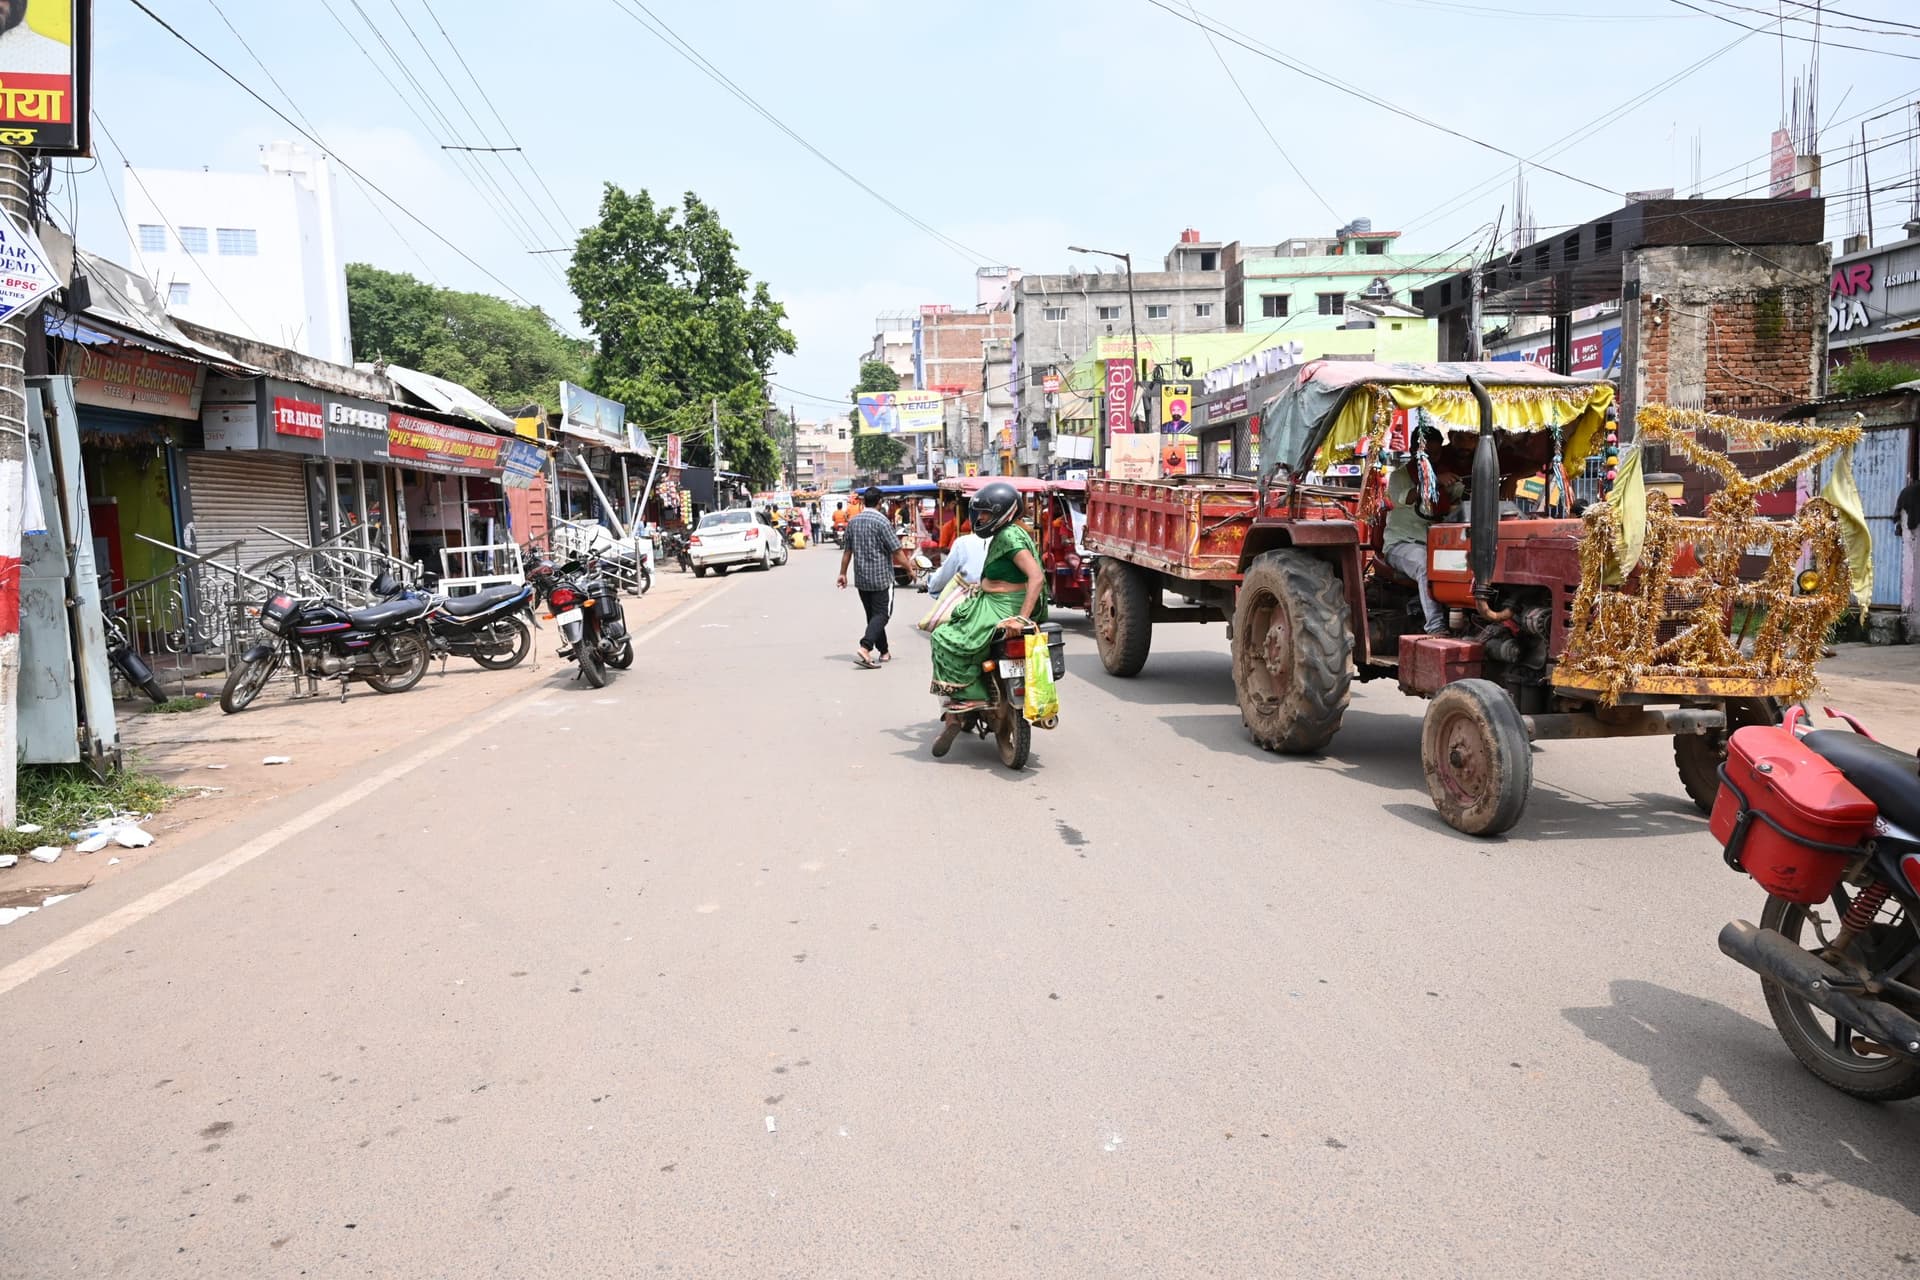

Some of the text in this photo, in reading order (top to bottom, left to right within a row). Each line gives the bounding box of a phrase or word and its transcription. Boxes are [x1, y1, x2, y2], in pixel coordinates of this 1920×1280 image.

[6, 278, 37, 291] BPSC
[82, 357, 100, 378] SAI
[103, 360, 132, 384] BABA
[134, 366, 193, 395] FABRICATION
[103, 384, 123, 398] STEEL
[901, 400, 939, 411] VENUS
[280, 407, 322, 429] FRANKE
[410, 432, 443, 452] WINDOW
[450, 441, 473, 457] DOORS
